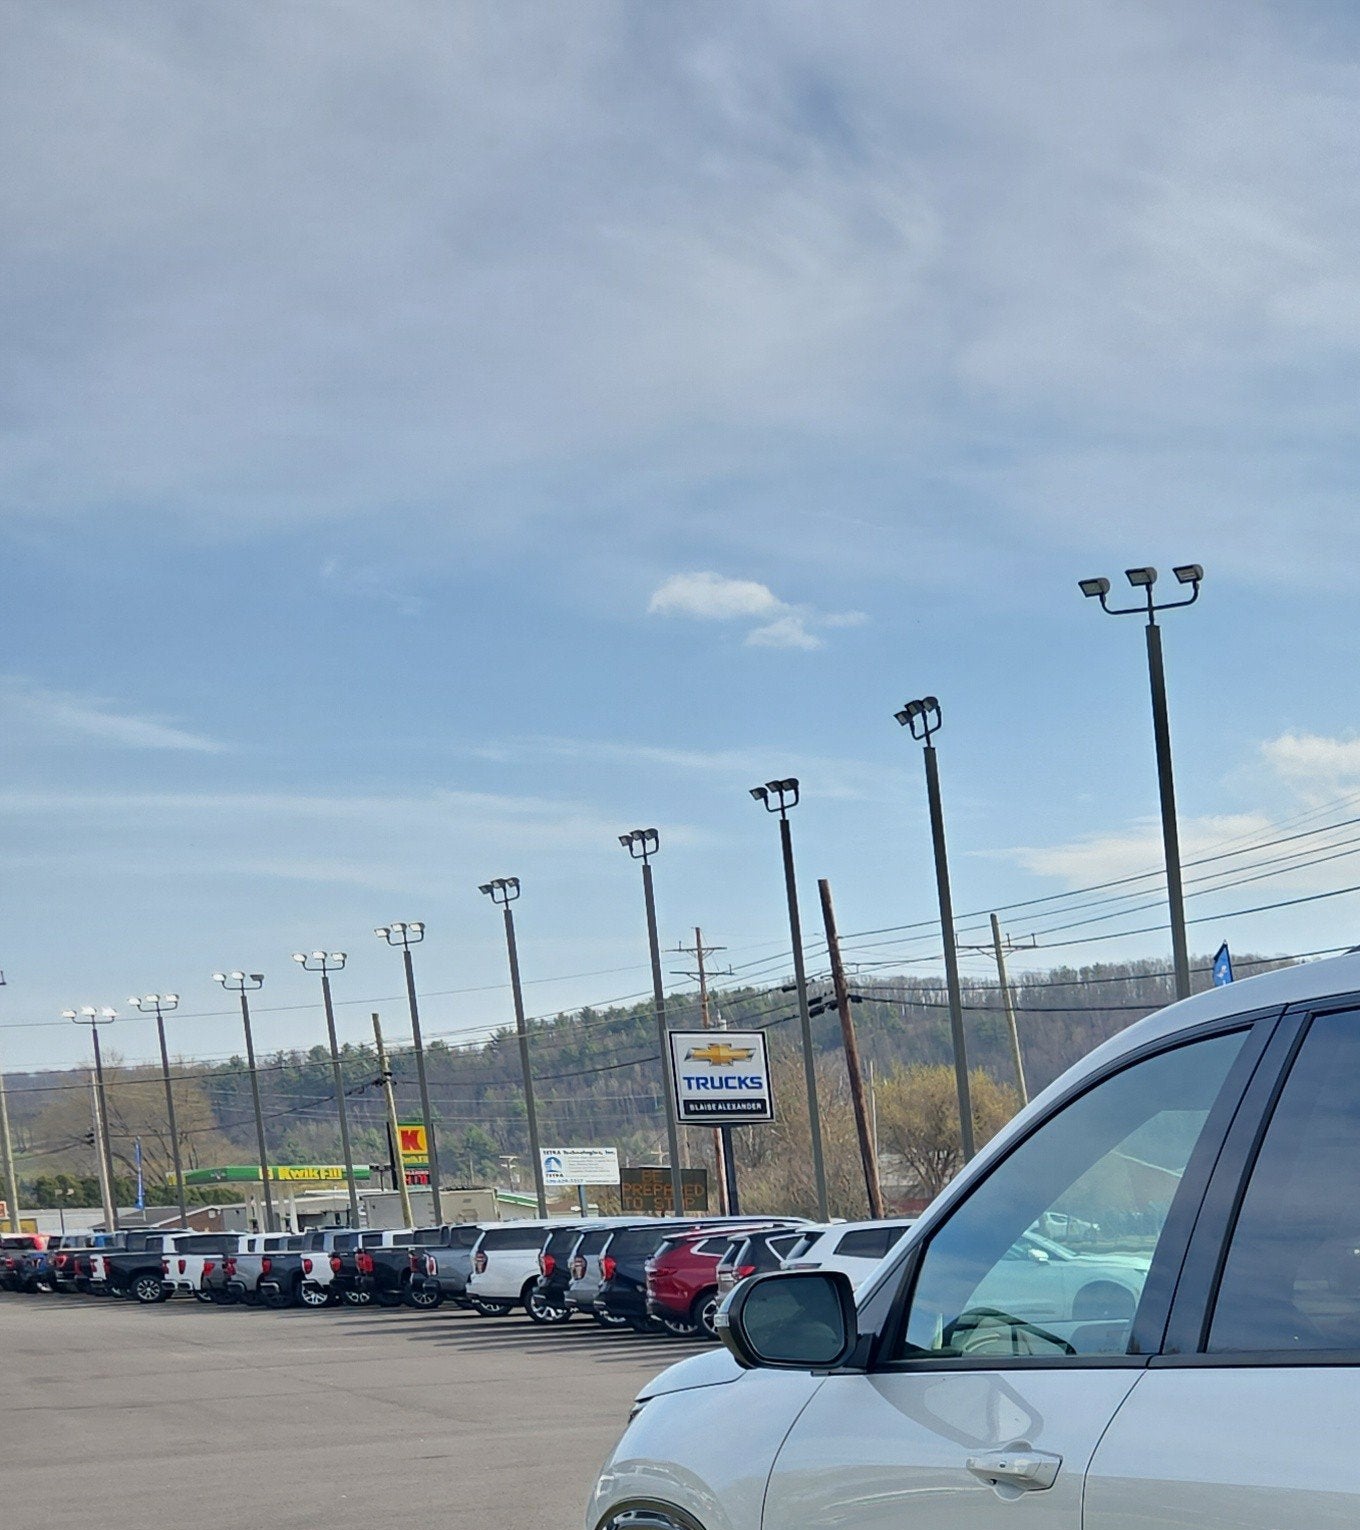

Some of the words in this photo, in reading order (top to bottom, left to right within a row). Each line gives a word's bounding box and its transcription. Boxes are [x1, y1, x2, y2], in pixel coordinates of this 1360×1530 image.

[683, 1076, 763, 1090] TRUCKS
[718, 1102, 762, 1111] ALEXANDER
[400, 1129, 425, 1151] K
[622, 1183, 704, 1197] PREPAED
[654, 1198, 695, 1211] STP
